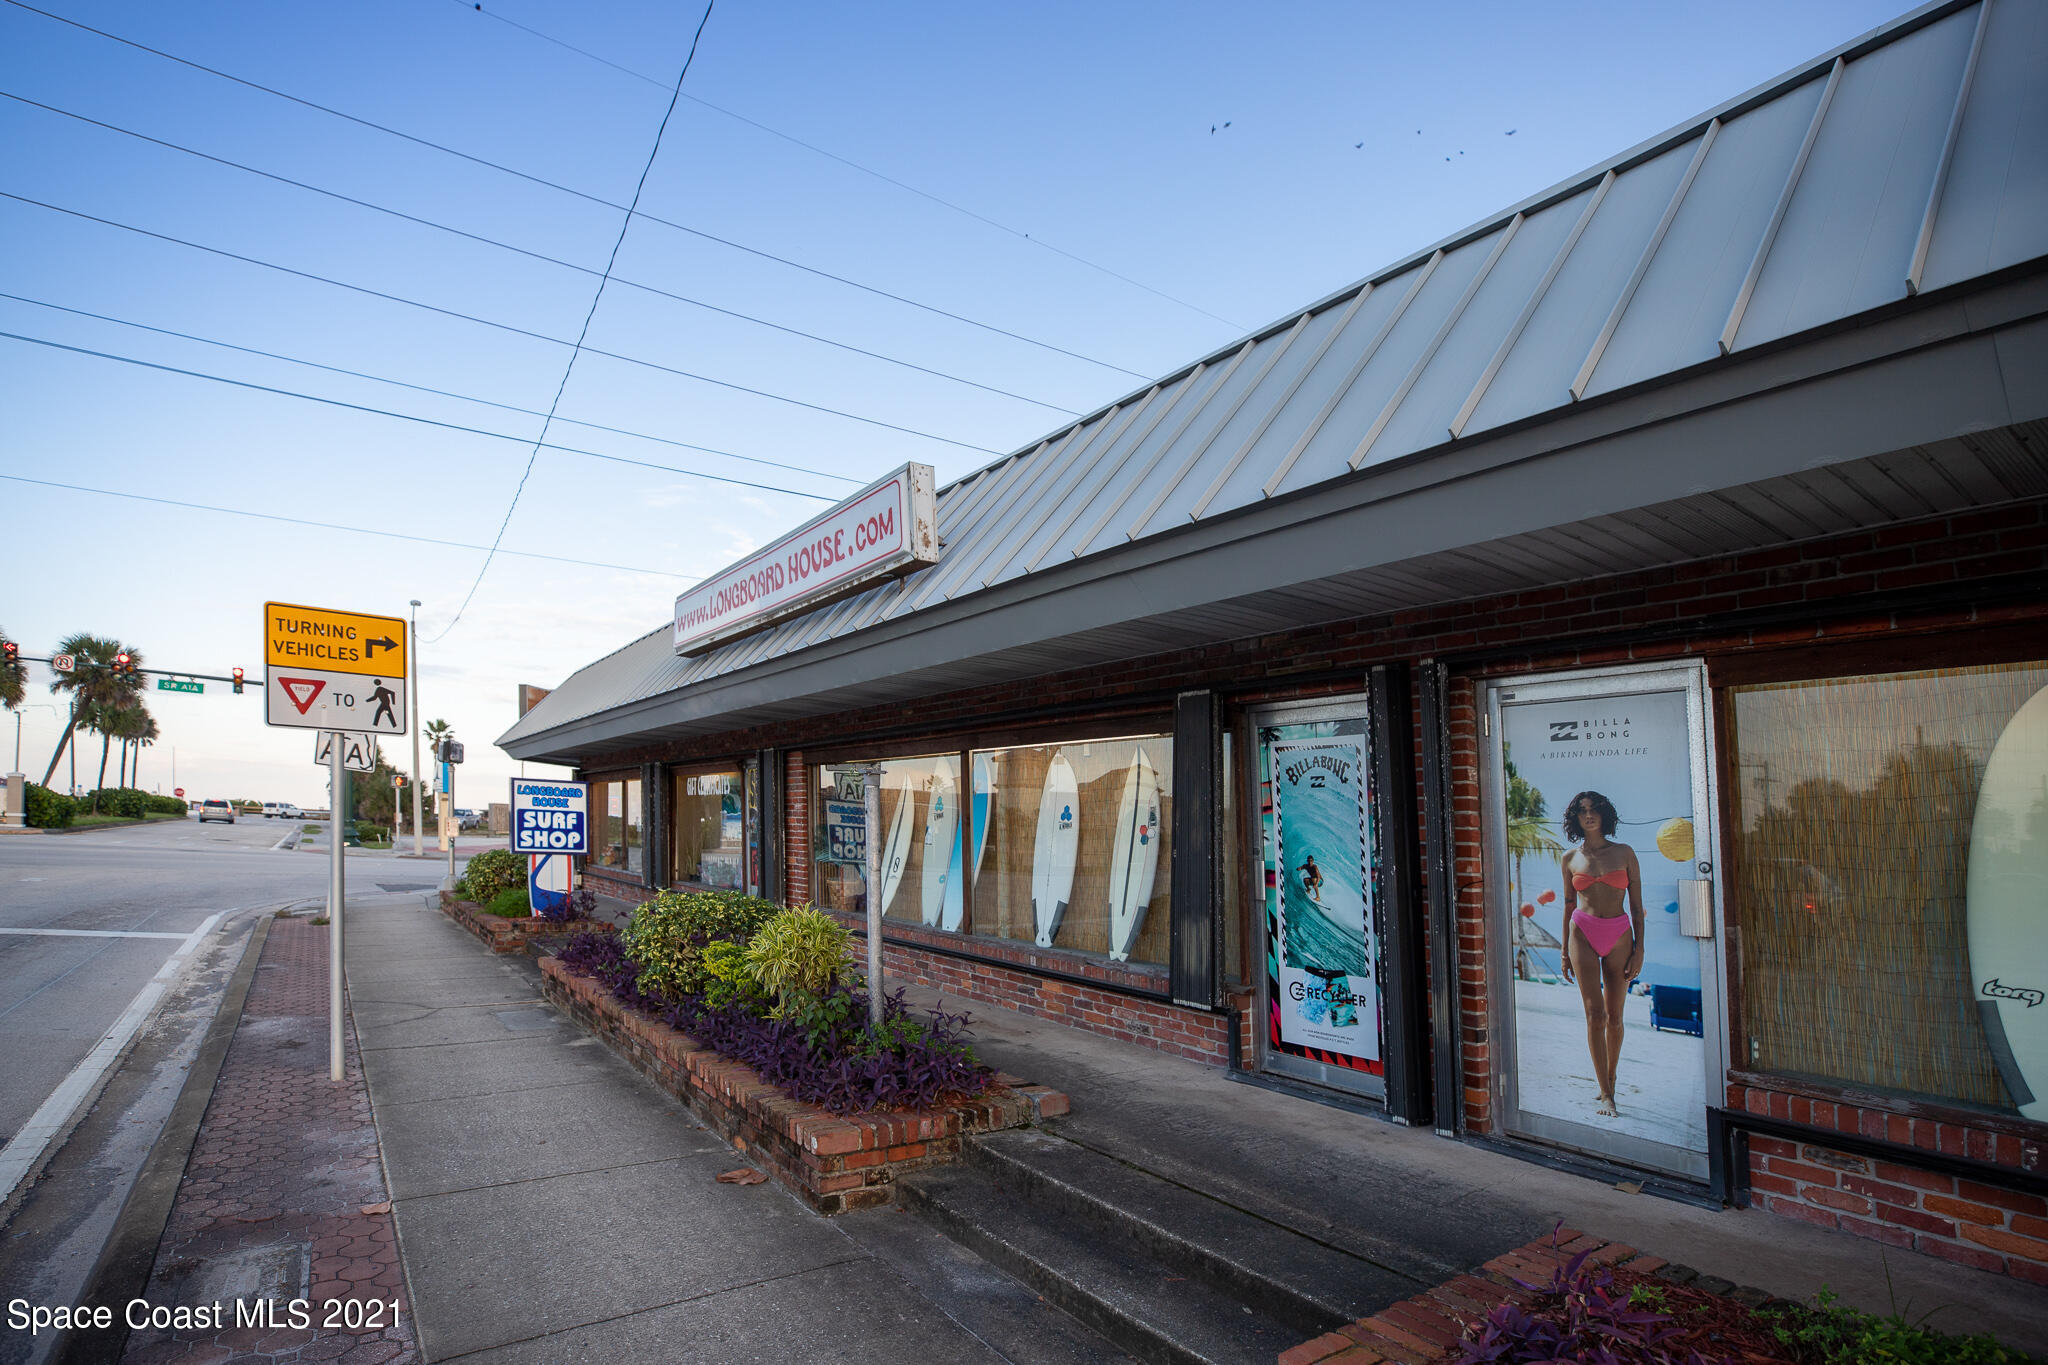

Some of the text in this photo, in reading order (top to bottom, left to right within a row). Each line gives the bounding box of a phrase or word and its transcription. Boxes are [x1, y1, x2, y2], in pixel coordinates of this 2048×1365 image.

[275, 617, 357, 640] TURNING
[273, 639, 359, 662] VEHICLES
[163, 681, 199, 692] SR A1A
[333, 692, 355, 708] TO
[1583, 717, 1631, 728] BILLA
[1586, 730, 1630, 740] BONG
[1549, 750, 1583, 759] BIKINI
[1585, 748, 1620, 757] KINDA
[1624, 747, 1649, 756] LIFE
[1285, 755, 1351, 786] BILLABONG
[516, 784, 584, 799] LONGBOARD
[686, 777, 697, 796] GIFT
[531, 796, 570, 809] HOUSE
[523, 811, 577, 830] SURF
[520, 830, 581, 849] SHOP
[1307, 986, 1367, 1008] RECYCLER
[1981, 978, 2045, 1009] torq
